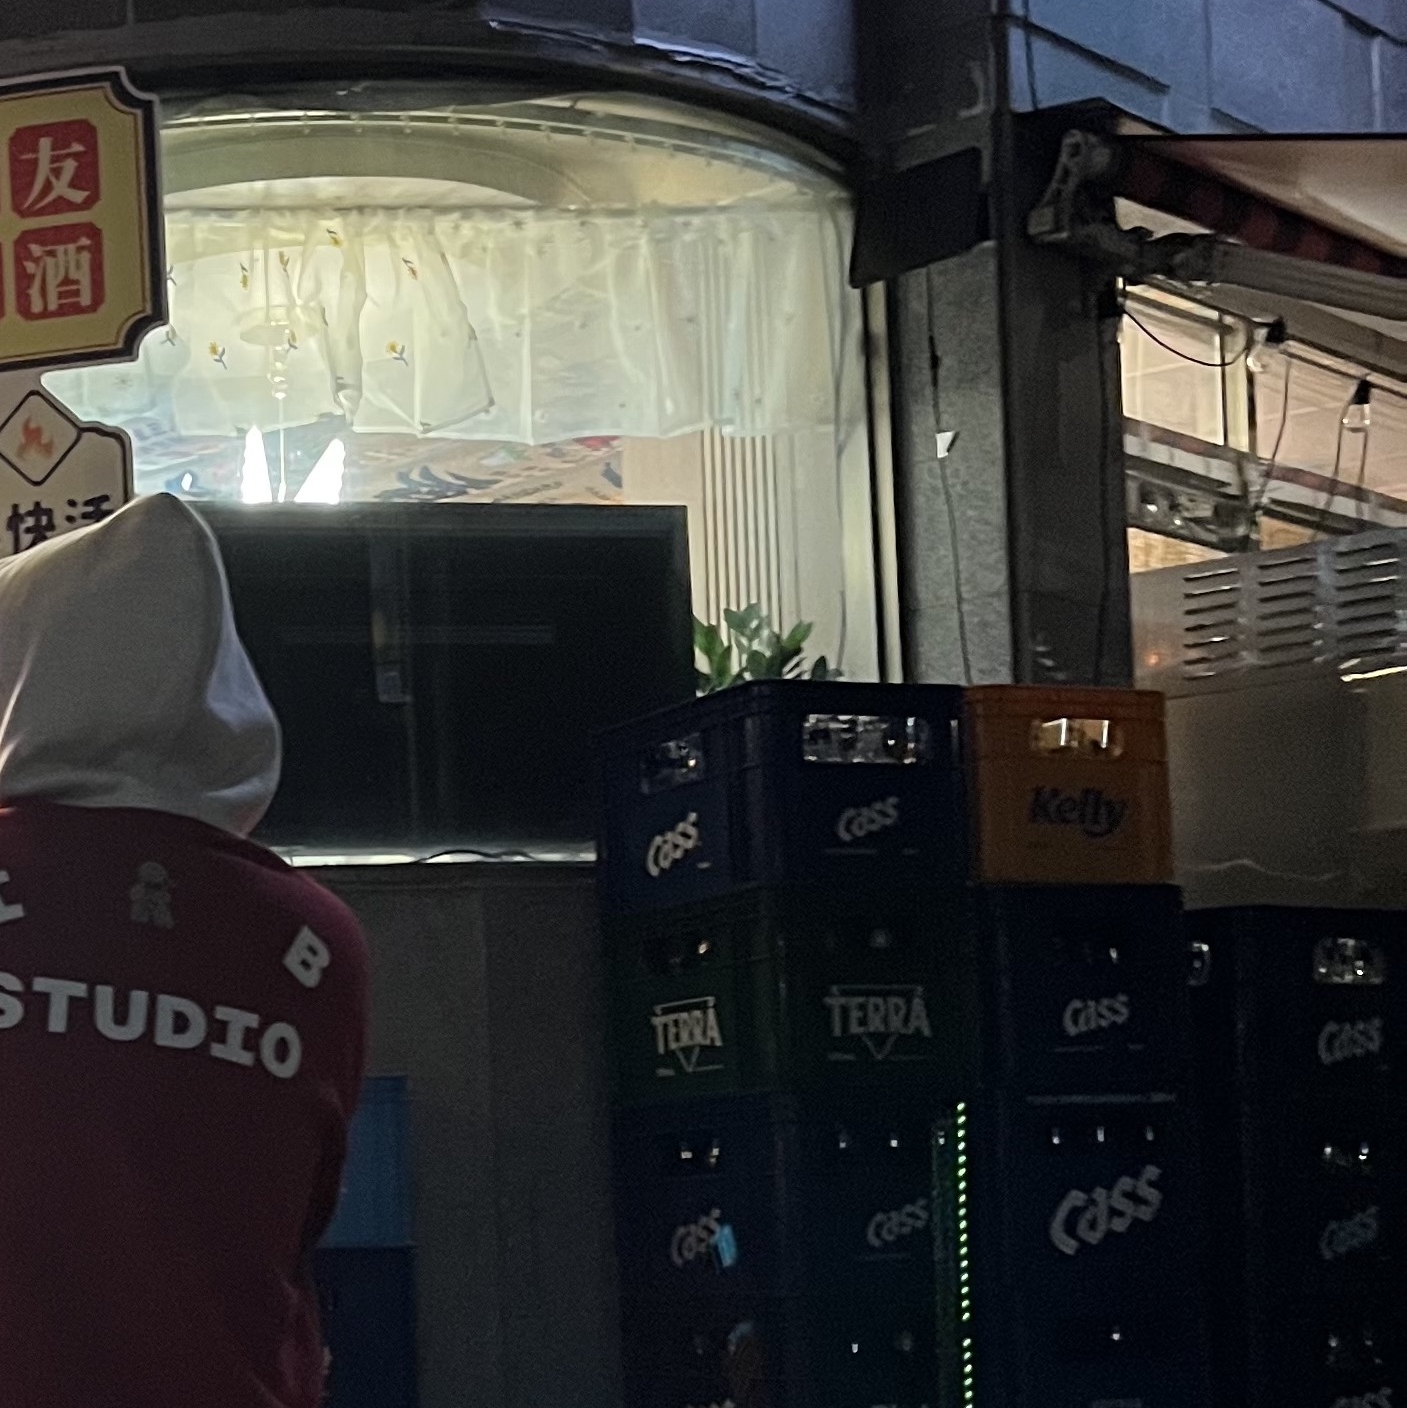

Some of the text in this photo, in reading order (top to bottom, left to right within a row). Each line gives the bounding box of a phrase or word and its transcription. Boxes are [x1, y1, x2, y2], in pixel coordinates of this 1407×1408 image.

[1028, 785, 1128, 838] Kelly
[282, 925, 332, 988] B
[650, 1007, 723, 1055] TERRA
[823, 995, 932, 1037] TERRA
